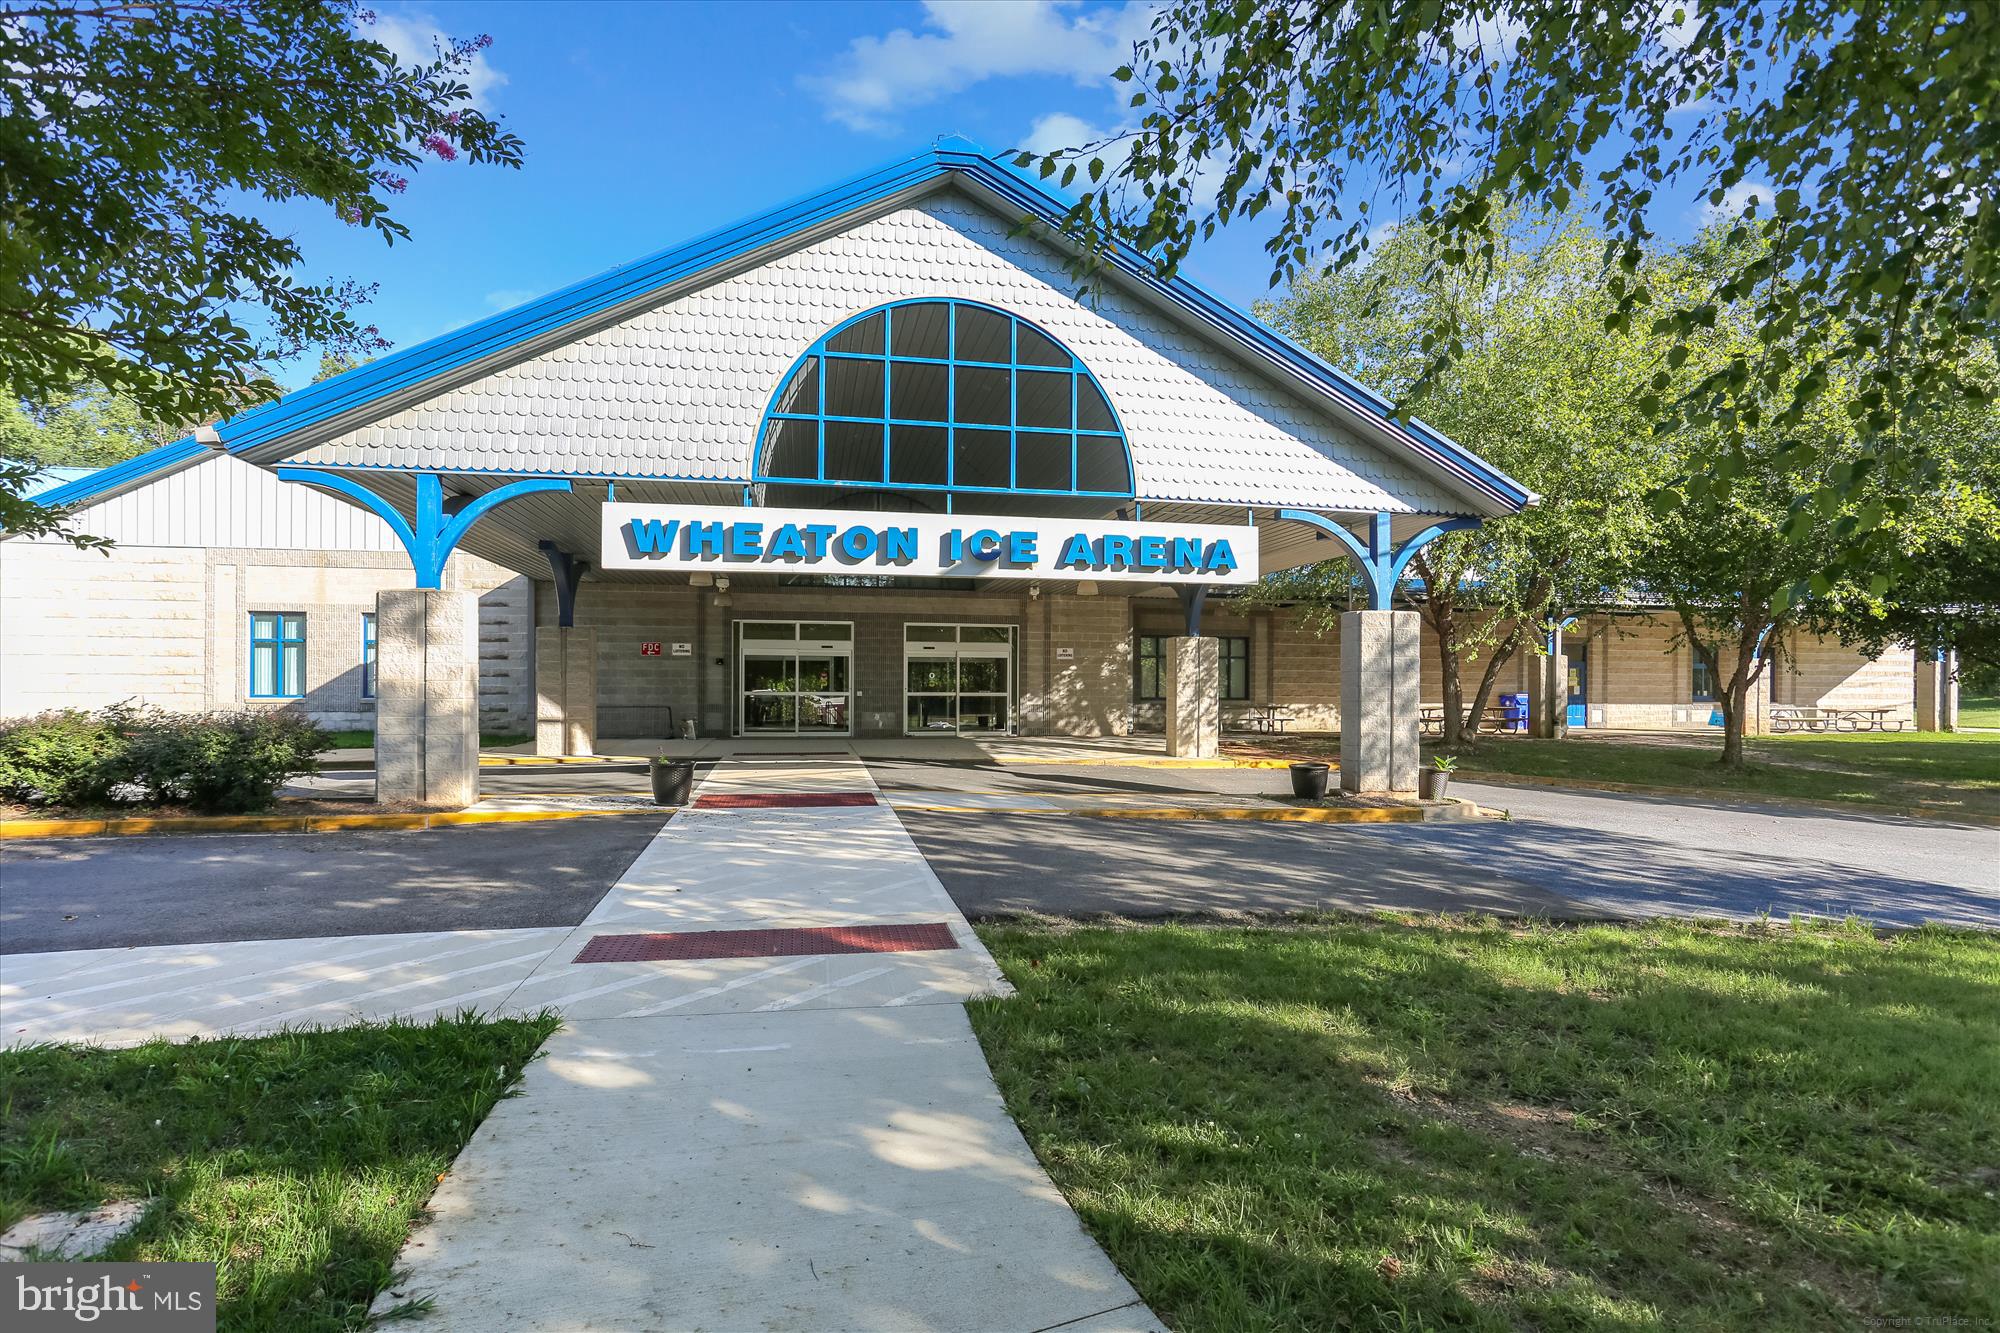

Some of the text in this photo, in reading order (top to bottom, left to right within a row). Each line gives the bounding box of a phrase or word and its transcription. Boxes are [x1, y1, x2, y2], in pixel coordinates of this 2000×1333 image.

[631, 519, 1238, 570] WHEATON ICE ARENA
[642, 643, 660, 651] FDC
